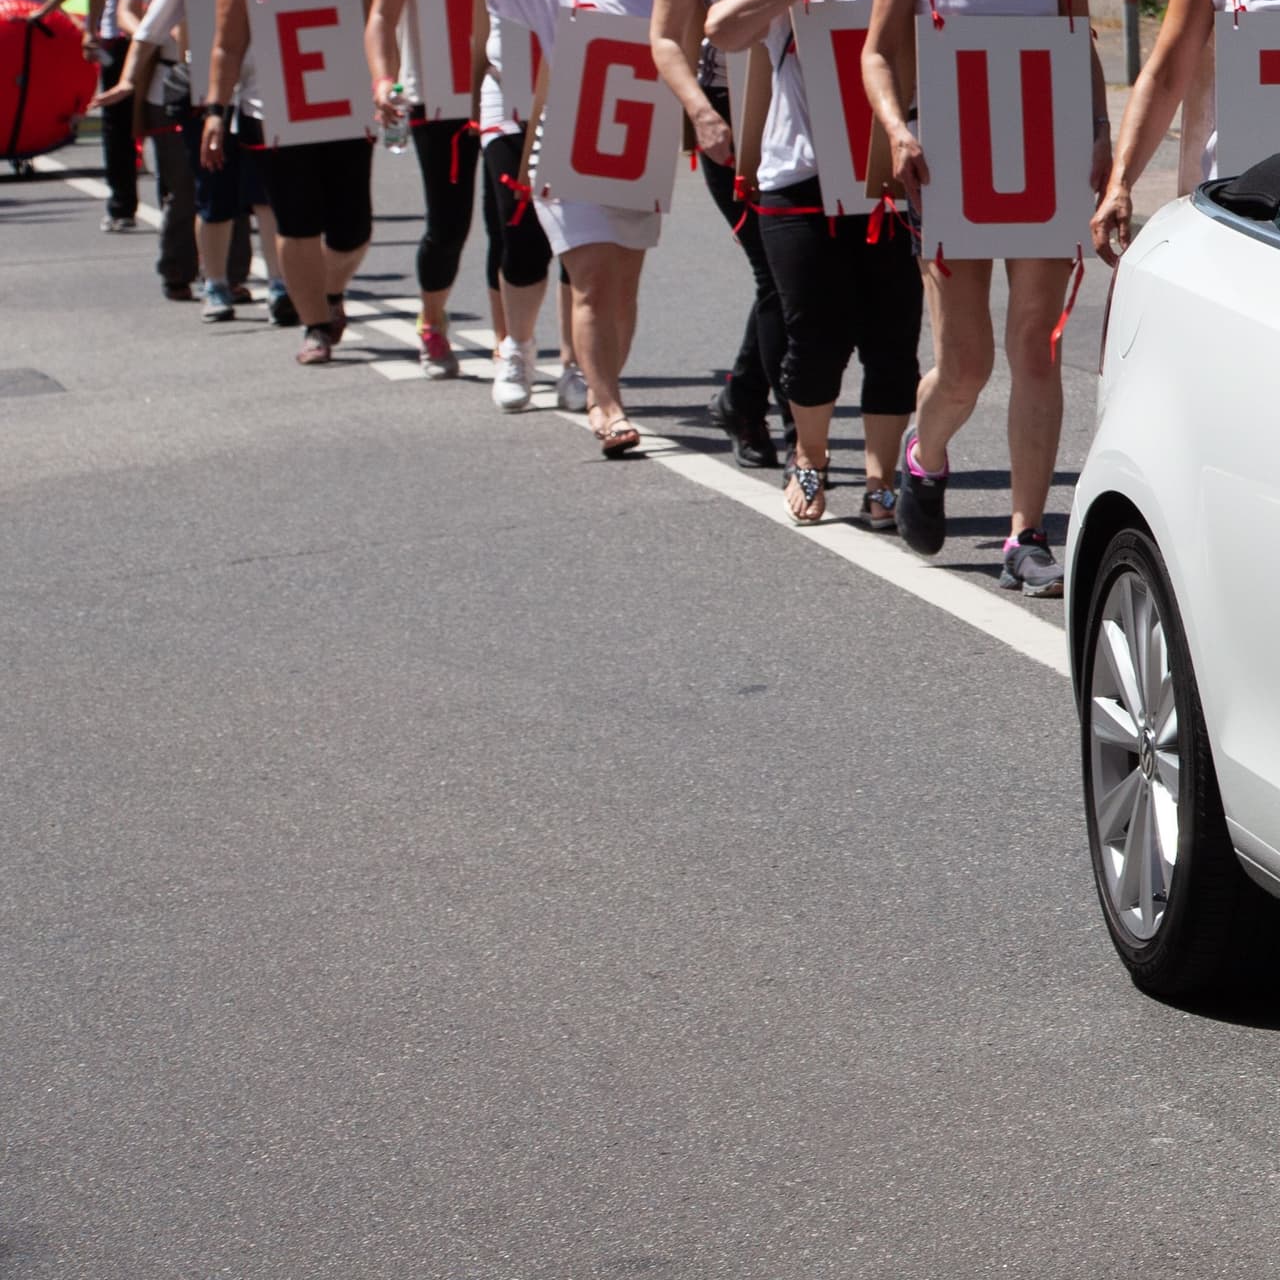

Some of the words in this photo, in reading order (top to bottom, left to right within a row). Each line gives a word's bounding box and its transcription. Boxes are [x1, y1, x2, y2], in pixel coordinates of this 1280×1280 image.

[276, 7, 351, 124] E
[570, 37, 660, 182] G
[955, 49, 1058, 225] U
